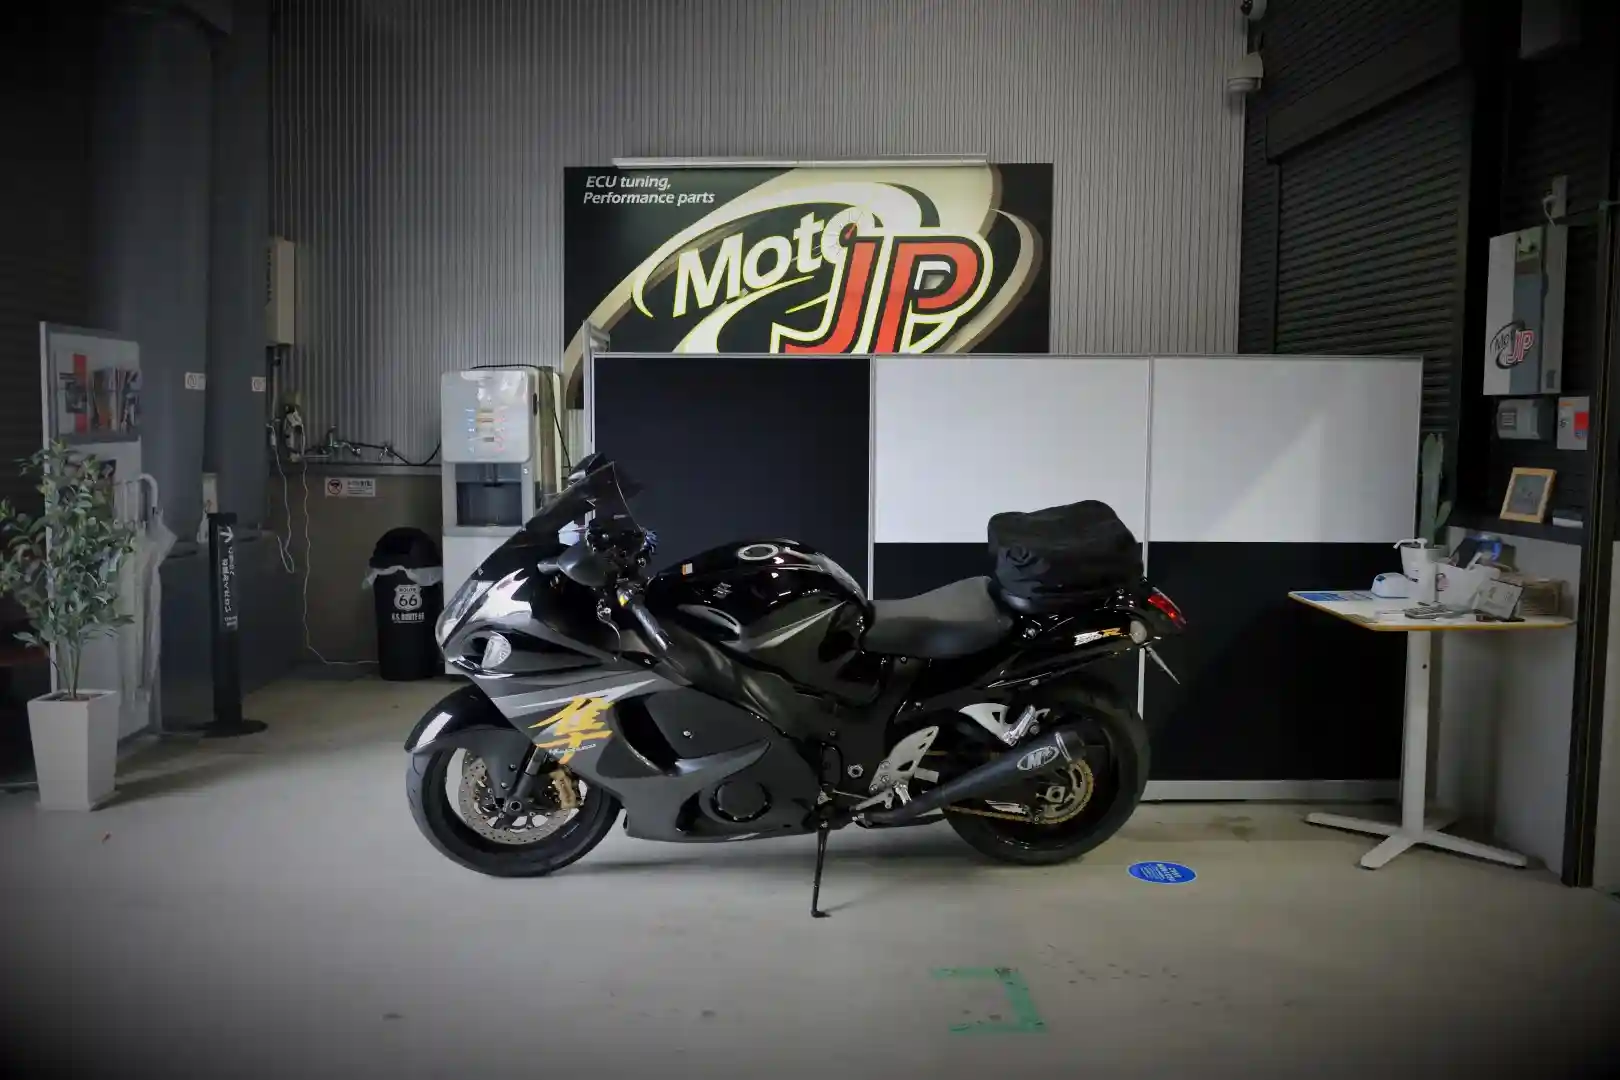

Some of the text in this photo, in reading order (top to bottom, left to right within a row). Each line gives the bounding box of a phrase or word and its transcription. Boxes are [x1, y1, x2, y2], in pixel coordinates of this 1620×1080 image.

[585, 175, 671, 190] ECU tuning,
[583, 192, 716, 206] Performance parts
[672, 206, 988, 354] Moto JP
[399, 594, 417, 606] 66
